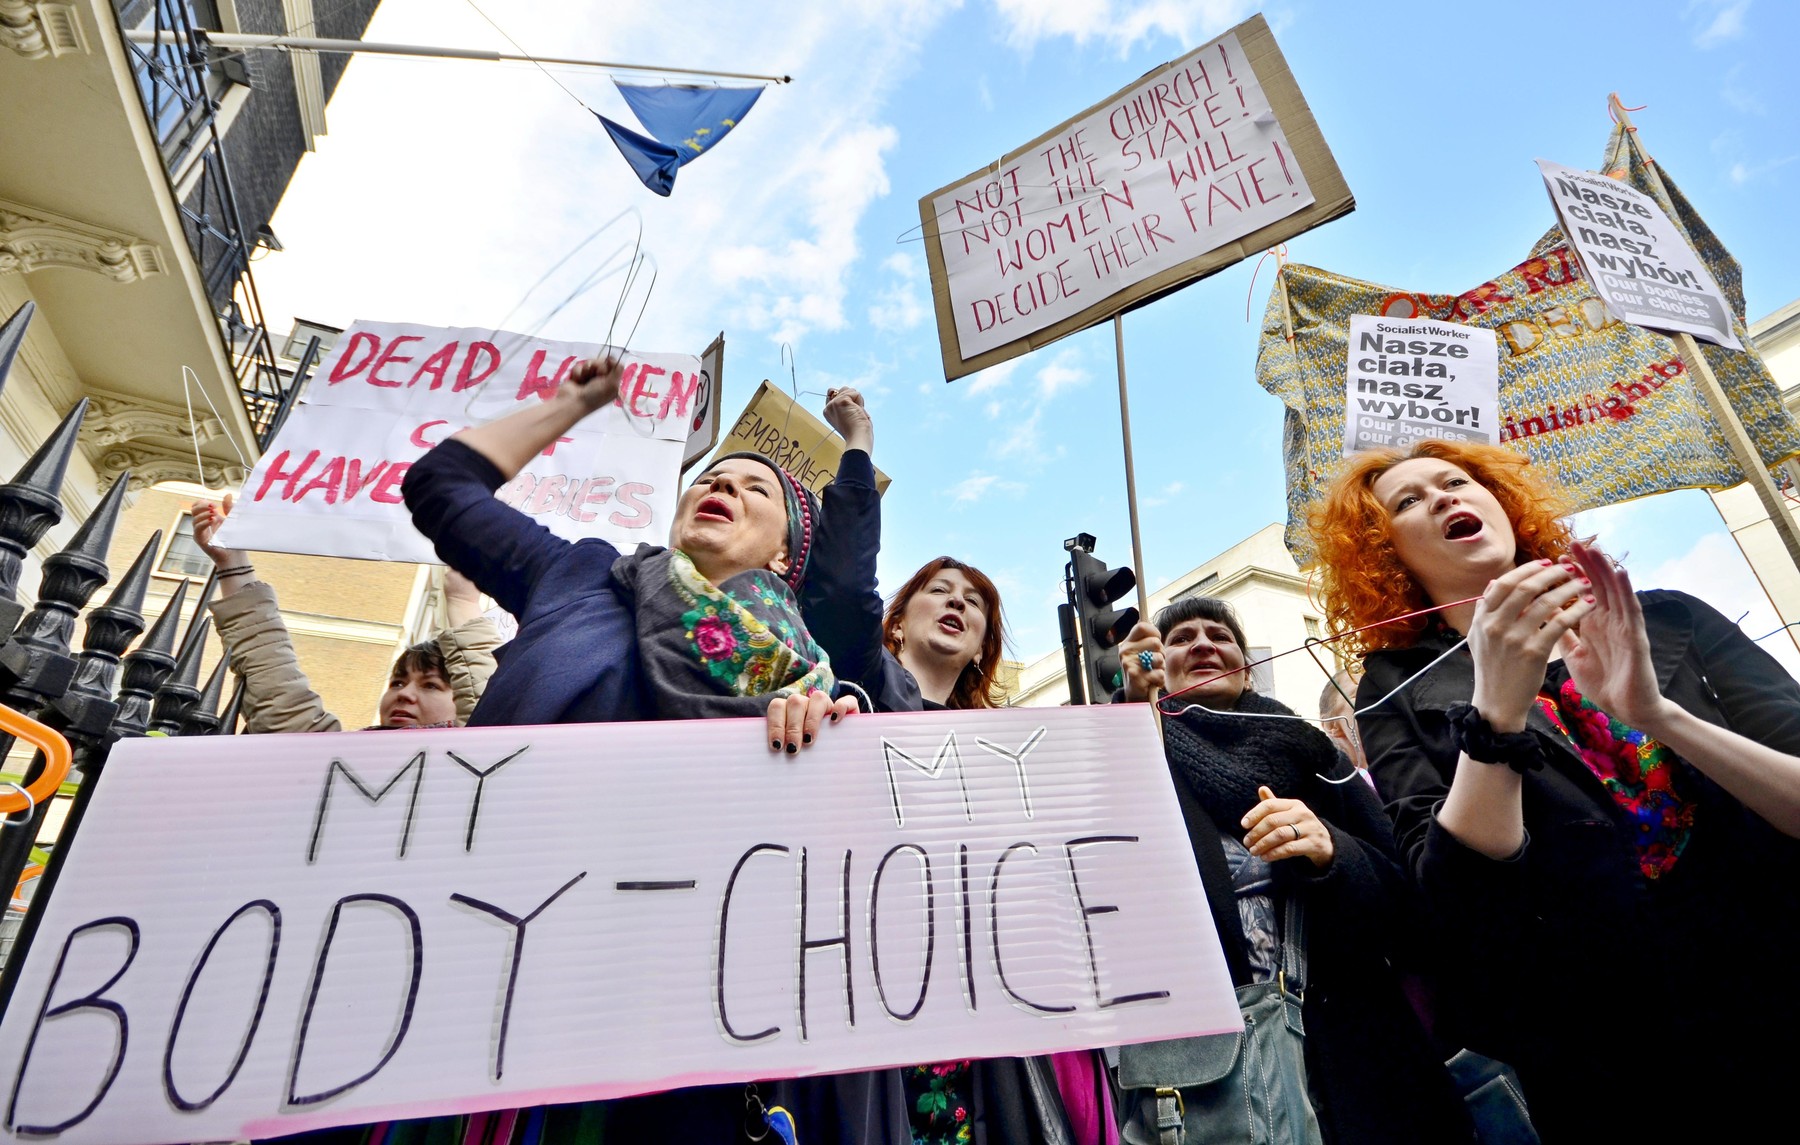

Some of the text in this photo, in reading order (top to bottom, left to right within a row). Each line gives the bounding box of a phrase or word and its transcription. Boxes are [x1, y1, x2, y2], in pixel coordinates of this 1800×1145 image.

[955, 166, 1021, 225] NOT
[1040, 127, 1094, 177] THE
[962, 198, 1025, 255] NOT
[1048, 158, 1105, 205] THE
[997, 131, 1248, 279] WOMEN WILL
[1554, 177, 1653, 219] Nasze
[1567, 203, 1657, 243] ciała,
[1578, 226, 1659, 260] nasz
[970, 259, 1080, 333] DECIDE
[1083, 214, 1176, 279] THEIR
[1588, 250, 1703, 291] wybór!
[1605, 274, 1638, 291] Our
[1611, 290, 1645, 307] our
[1648, 295, 1710, 319] choice
[1360, 331, 1469, 359] Nasze
[328, 331, 501, 393] DEAD
[515, 350, 698, 419] WEN
[1357, 355, 1456, 382] ciała,
[1357, 378, 1443, 400] nasz
[1357, 398, 1480, 428] wybór!
[1359, 416, 1395, 432] Our
[1358, 431, 1393, 445] our
[254, 450, 414, 505] HAVE
[497, 472, 655, 529] ABIES
[308, 725, 1048, 865] MY MY
[4, 871, 588, 1137] BODY
[713, 834, 1172, 1046] CHOICE
